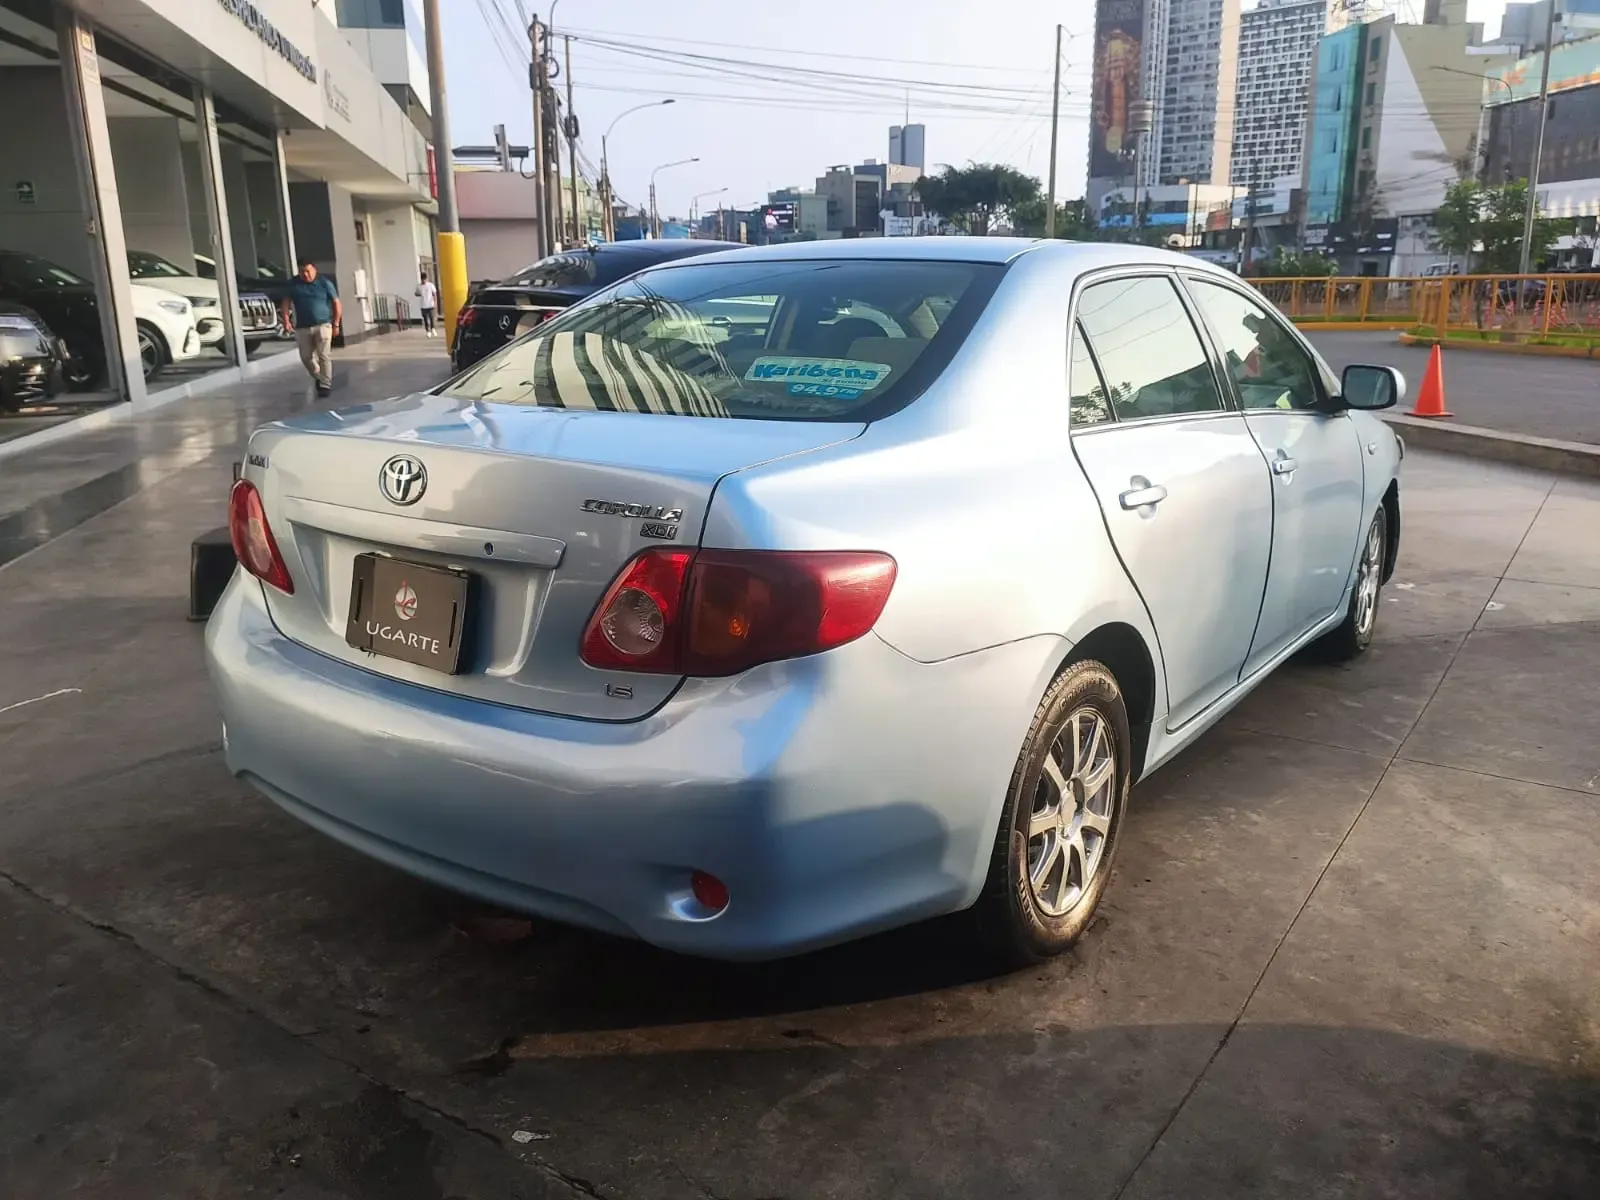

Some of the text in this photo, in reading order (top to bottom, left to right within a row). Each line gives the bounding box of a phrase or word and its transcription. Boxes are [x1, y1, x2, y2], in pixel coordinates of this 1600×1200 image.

[752, 363, 879, 381] Karibeña
[791, 383, 838, 396] 94.9
[580, 499, 683, 522] COROLLA
[366, 620, 440, 655] UGARTE
